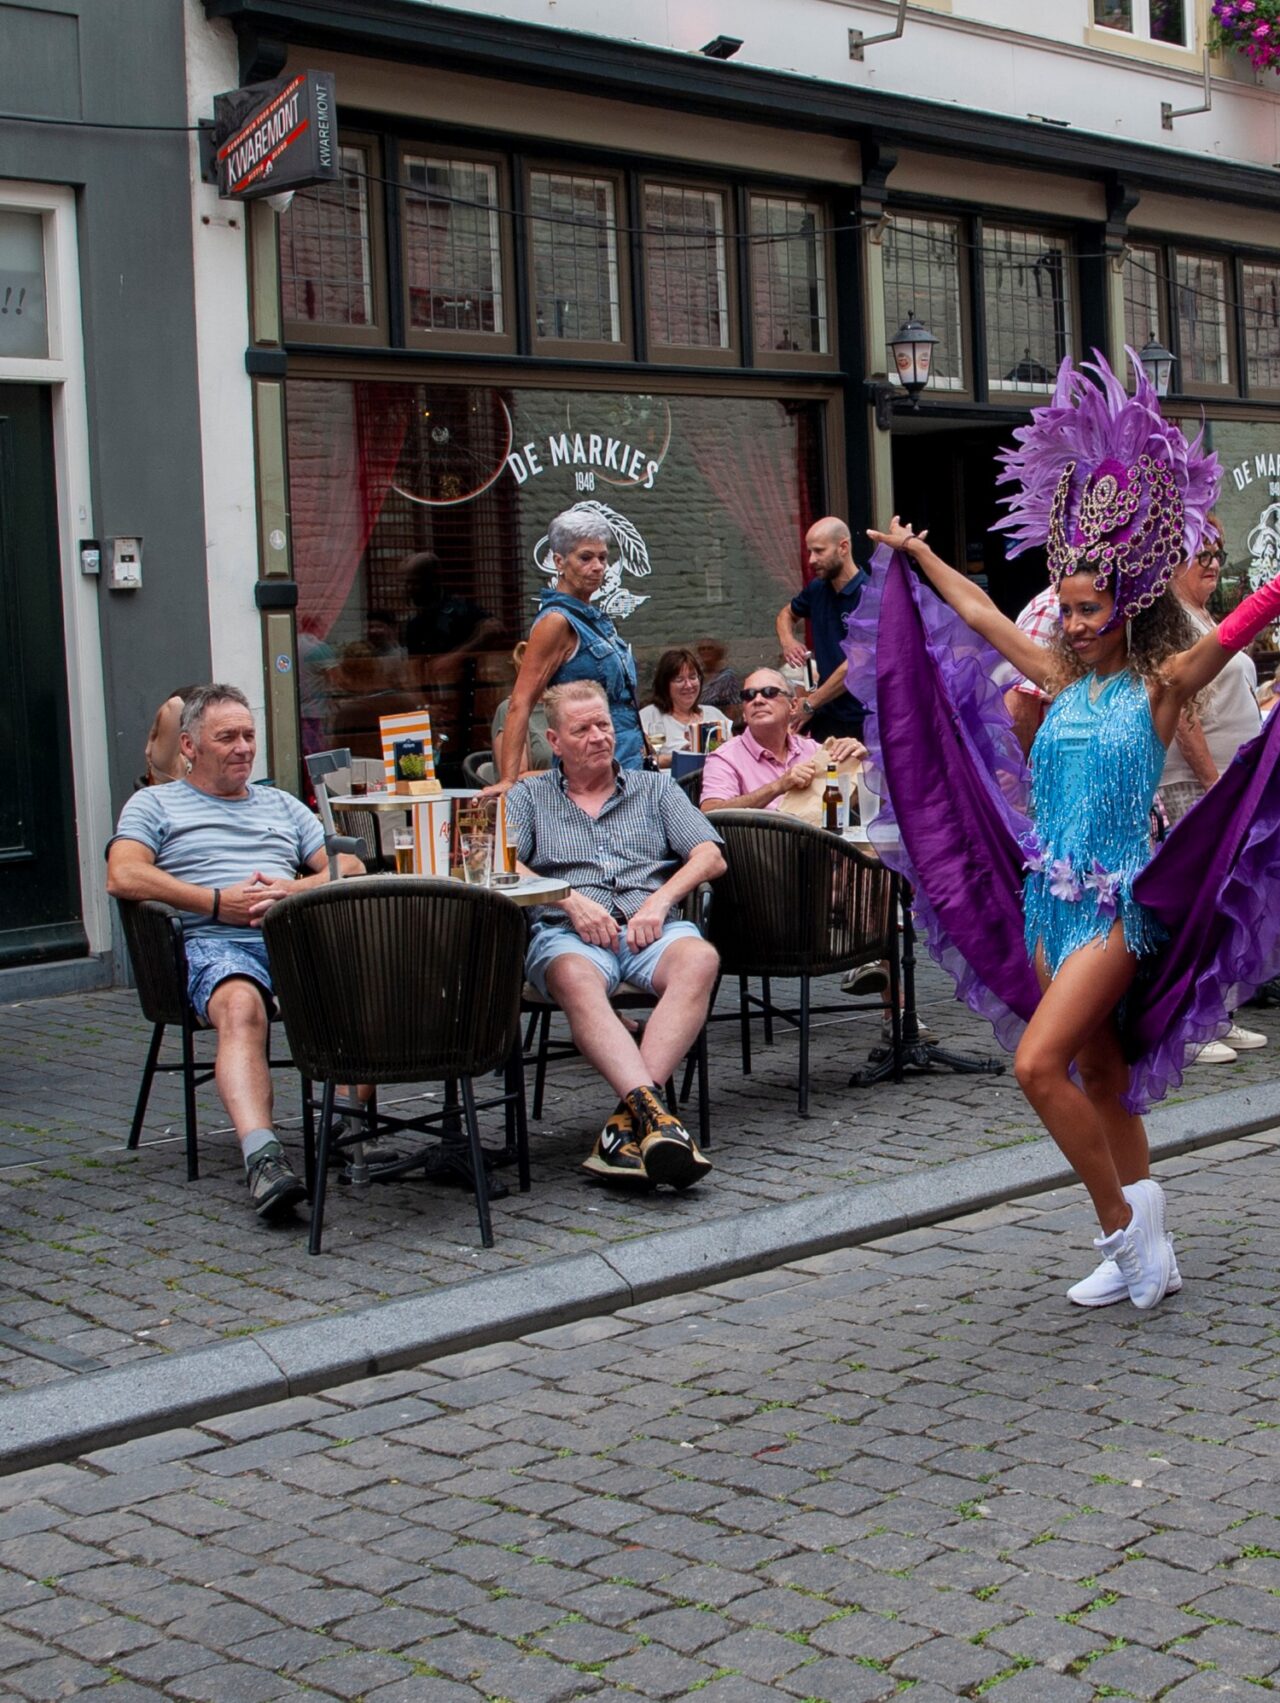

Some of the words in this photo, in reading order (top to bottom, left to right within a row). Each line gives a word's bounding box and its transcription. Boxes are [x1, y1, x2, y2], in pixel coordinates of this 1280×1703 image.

[228, 92, 299, 187] KWAREMONT
[316, 83, 331, 167] KWAREMONT
[507, 442, 543, 484] DE
[549, 433, 659, 489] MARKIES
[575, 472, 596, 492] 1948
[1232, 460, 1253, 491] DE
